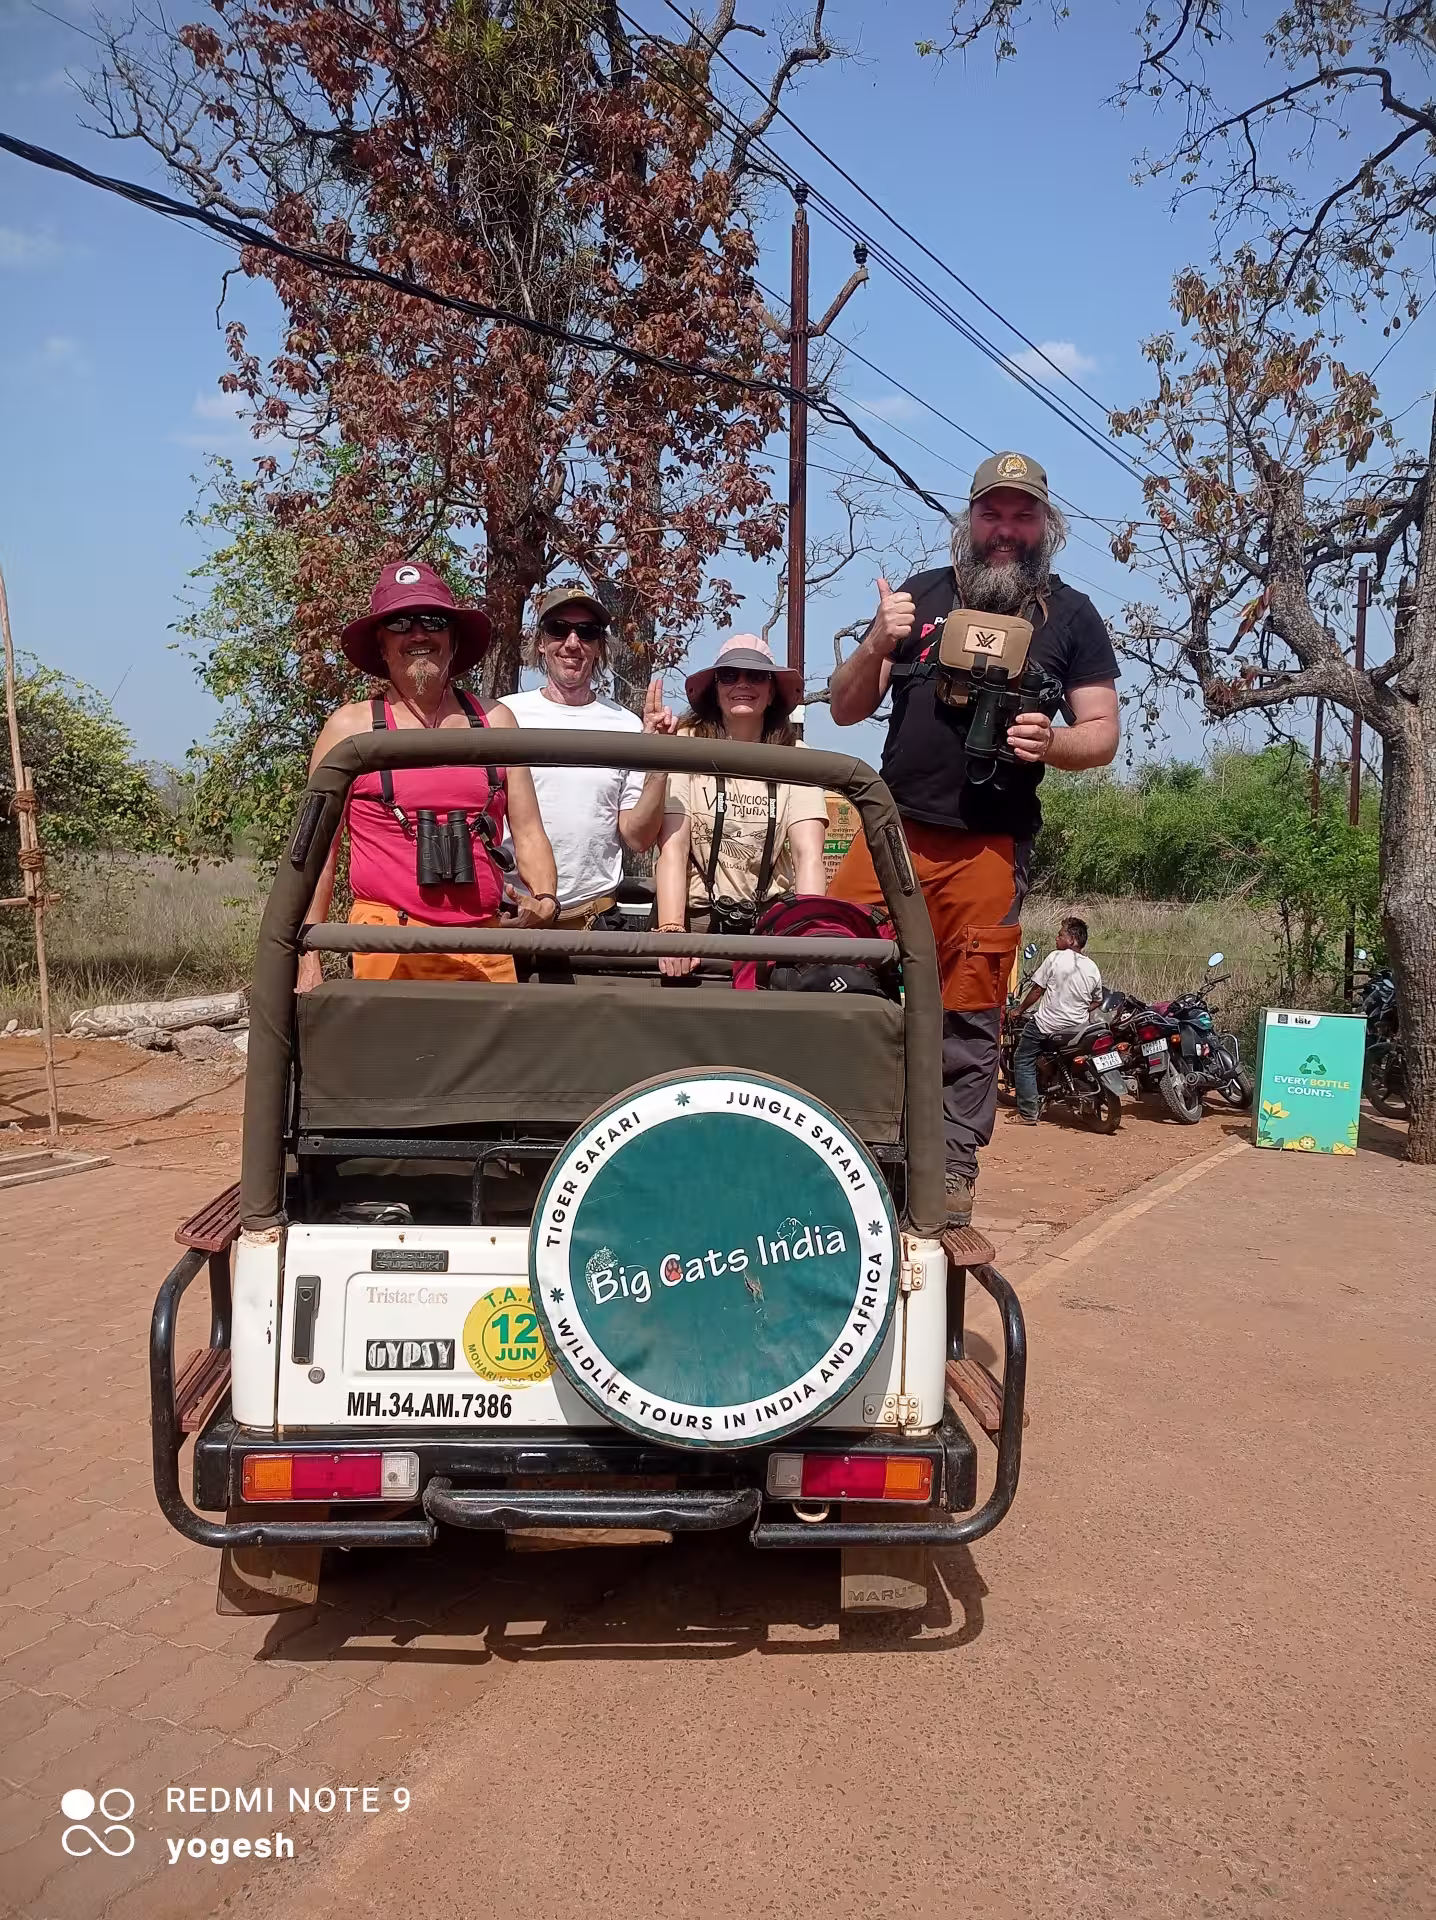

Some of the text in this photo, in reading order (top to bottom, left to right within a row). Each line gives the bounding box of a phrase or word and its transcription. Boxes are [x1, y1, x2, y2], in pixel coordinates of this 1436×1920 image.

[1274, 1075, 1350, 1090] EVERY BOTTLE
[1287, 1086, 1335, 1098] COUNTS.
[726, 1091, 866, 1192] JUNGLE SAFARI
[546, 1111, 641, 1248] TIGER SAFARI
[376, 1260, 445, 1271] SUZUKI
[592, 1225, 847, 1304] Big Cats India
[366, 1287, 448, 1305] Tristar Cars
[491, 1313, 538, 1345] 12
[556, 1251, 883, 1431] WILDLIFE TOURS IN INDIA AND AFRICA
[367, 1341, 454, 1369] GYPSY
[495, 1347, 537, 1361] JUN
[347, 1391, 513, 1419] MH.34.AM.7386
